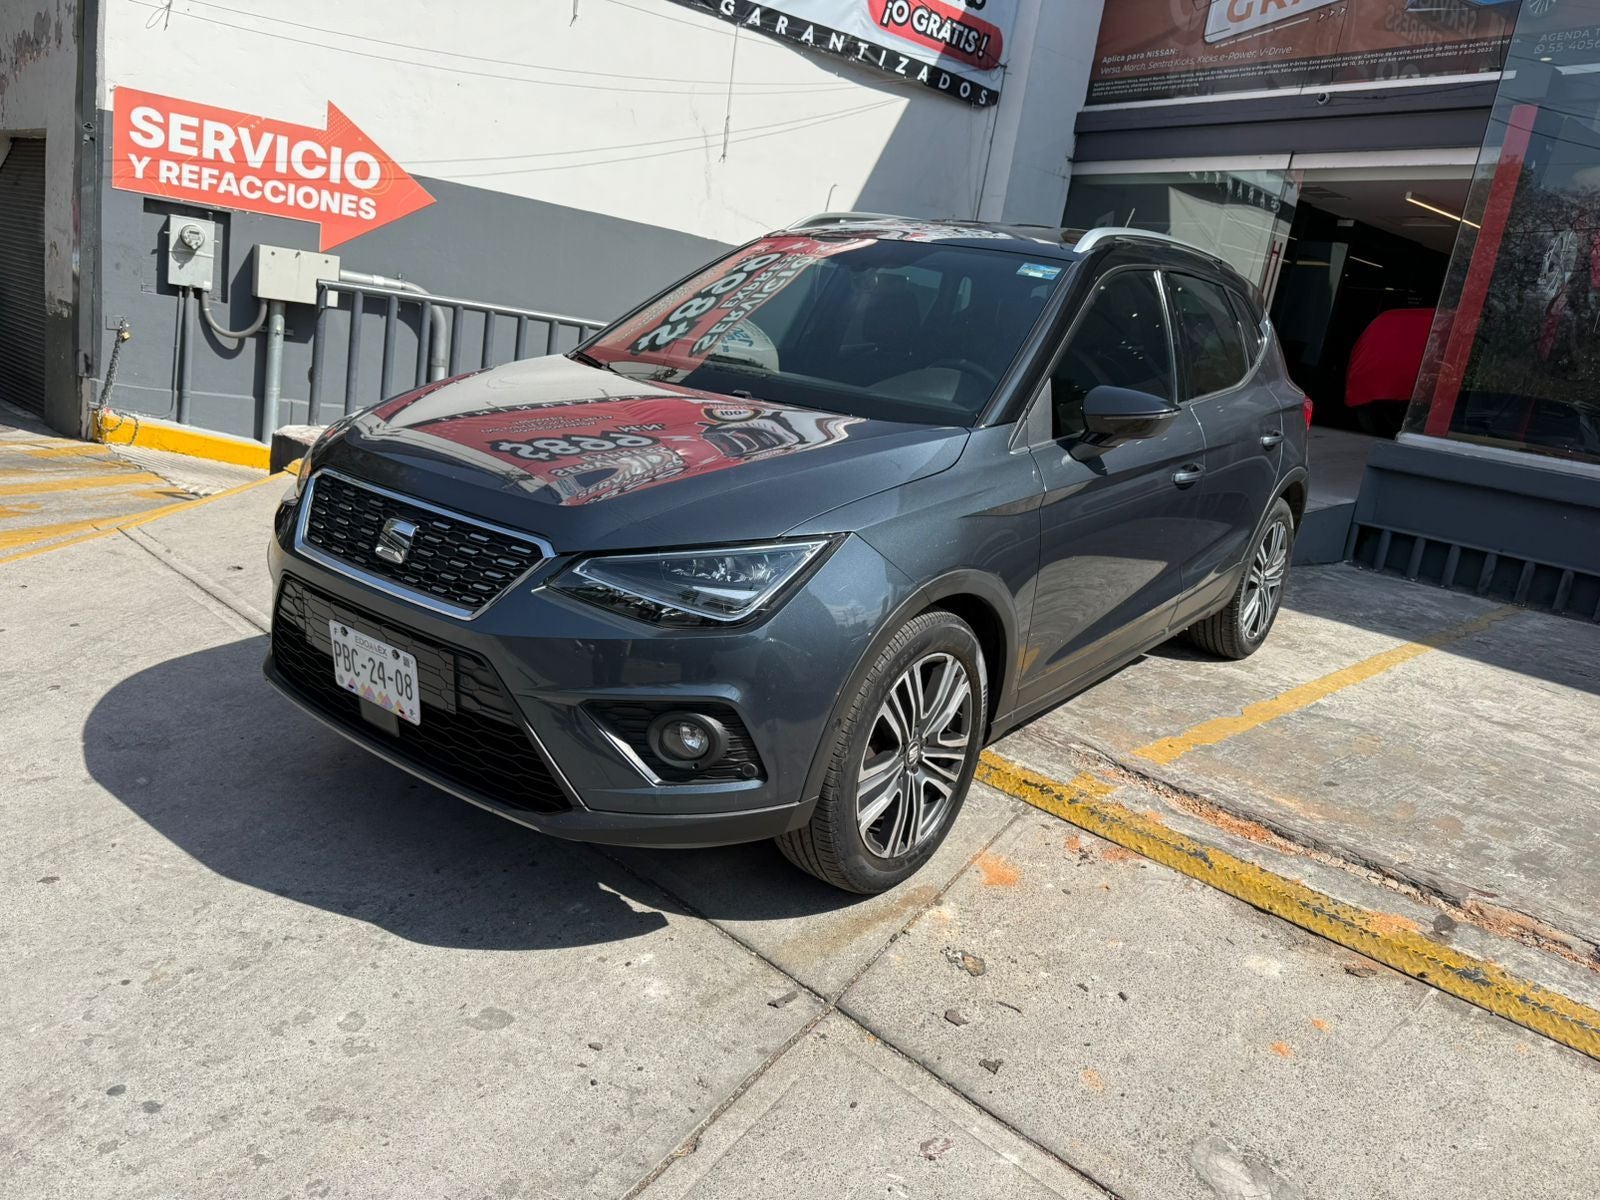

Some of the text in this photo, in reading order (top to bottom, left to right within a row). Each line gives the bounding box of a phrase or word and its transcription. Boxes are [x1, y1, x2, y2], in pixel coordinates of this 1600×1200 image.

[720, 0, 989, 105] GARANTIZADOS
[1102, 54, 1125, 64] Aplica
[1127, 52, 1145, 62] para
[1539, 30, 1590, 42] AGENDA
[128, 106, 381, 189] SERVICIO
[128, 153, 377, 220] Y REFACCIONES
[334, 640, 413, 701] PBC-24-08
